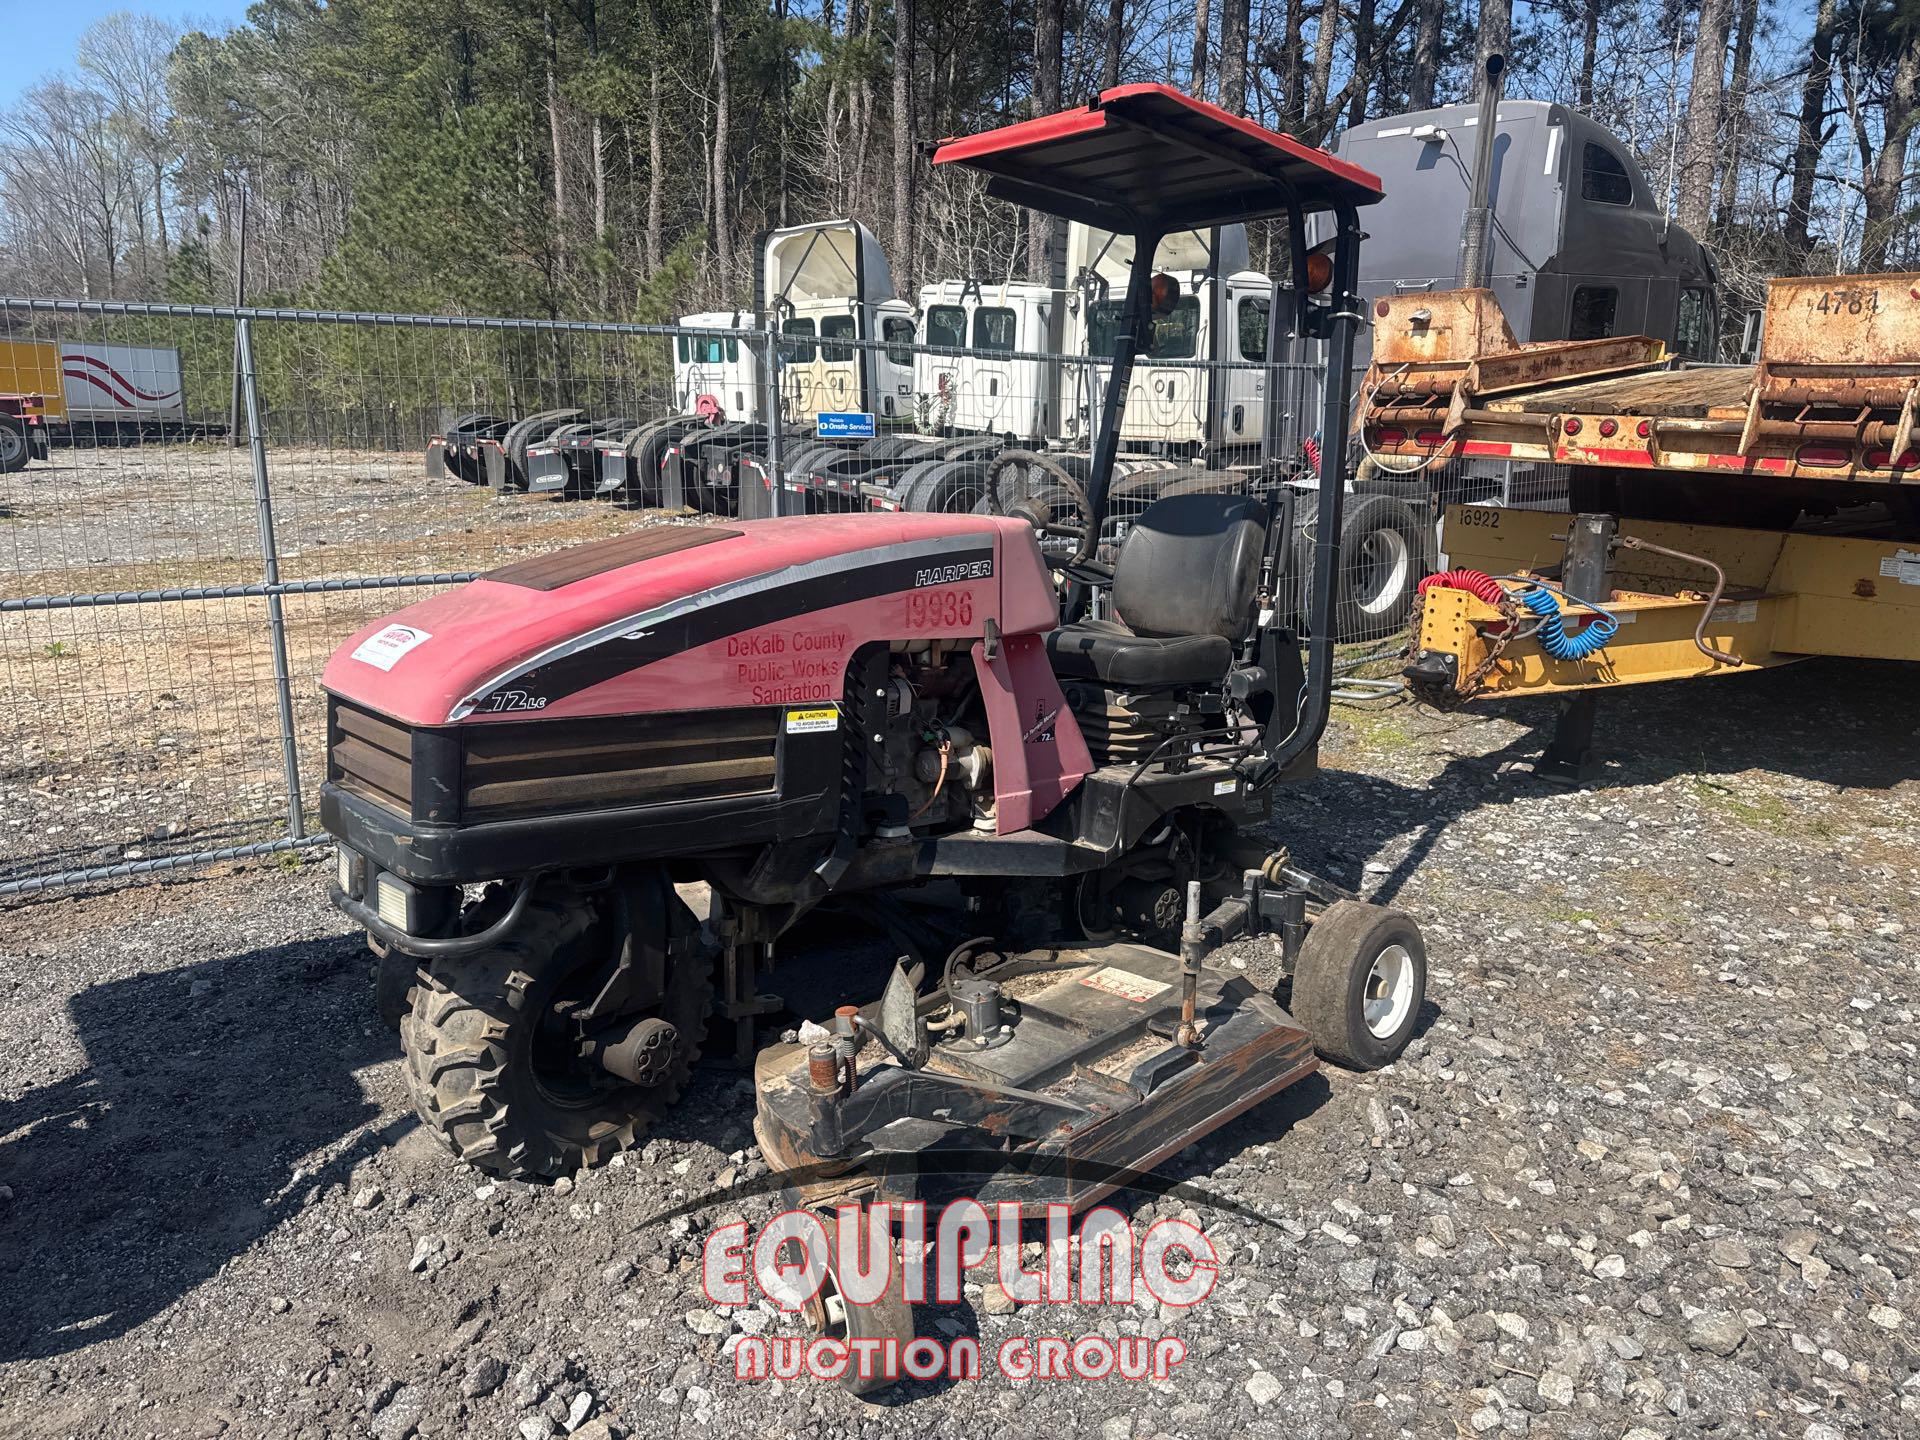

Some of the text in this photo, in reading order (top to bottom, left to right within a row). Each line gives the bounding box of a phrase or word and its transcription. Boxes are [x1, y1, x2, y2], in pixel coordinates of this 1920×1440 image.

[849, 423, 872, 431] Services
[1459, 509, 1500, 528] 16922
[915, 560, 992, 587] HARPER
[905, 591, 973, 629] 19936
[727, 631, 846, 657] DeKalb County
[738, 658, 839, 683] Public Works
[752, 681, 831, 704] Sanitation
